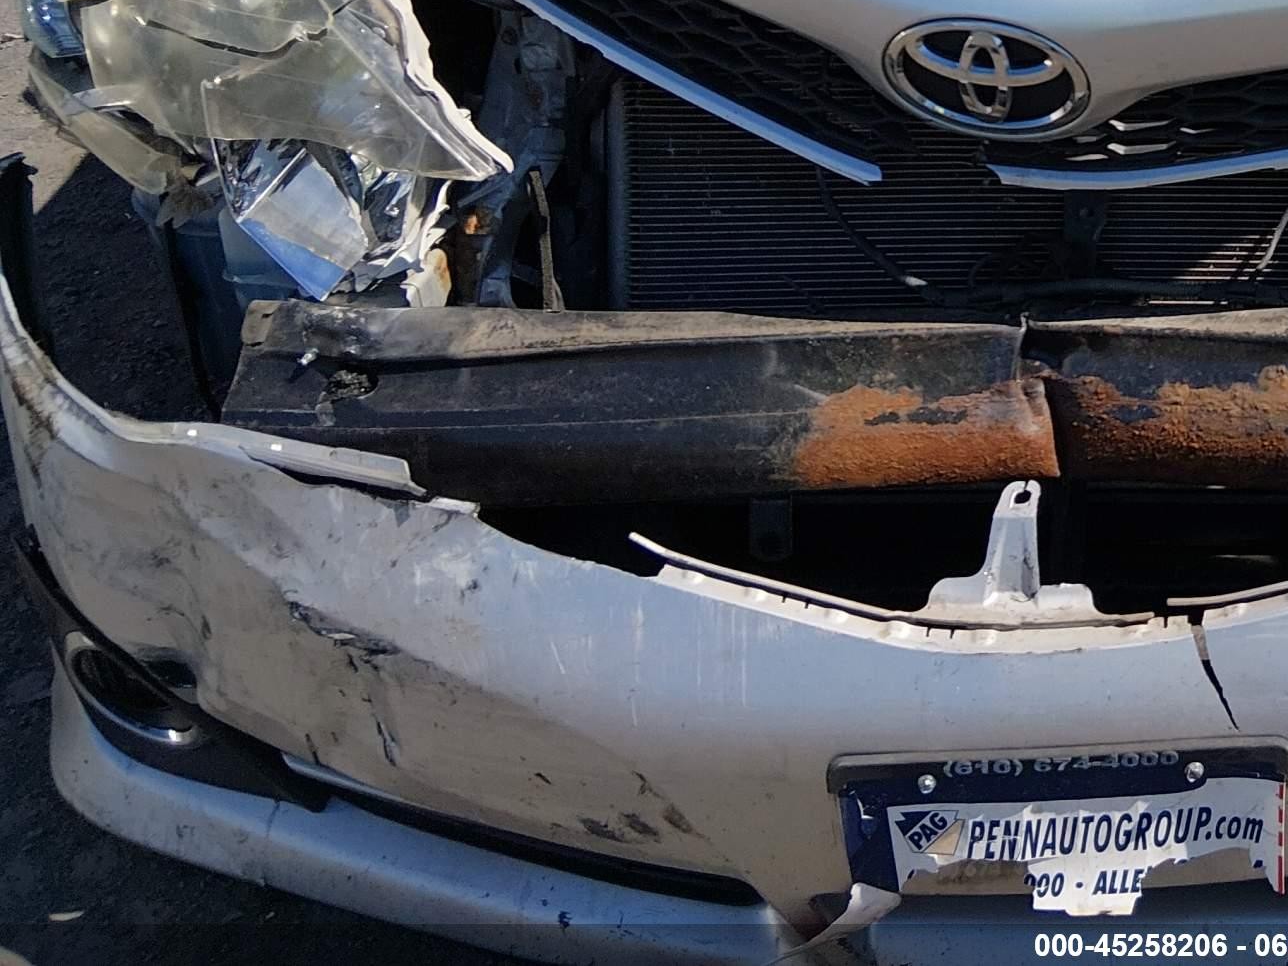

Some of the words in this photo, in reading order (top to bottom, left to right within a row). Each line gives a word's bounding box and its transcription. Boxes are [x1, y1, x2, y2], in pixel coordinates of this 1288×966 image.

[908, 811, 948, 851] PAG
[967, 806, 1264, 859] PENNAUTOGROUP.com
[1092, 867, 1152, 896] ALLE
